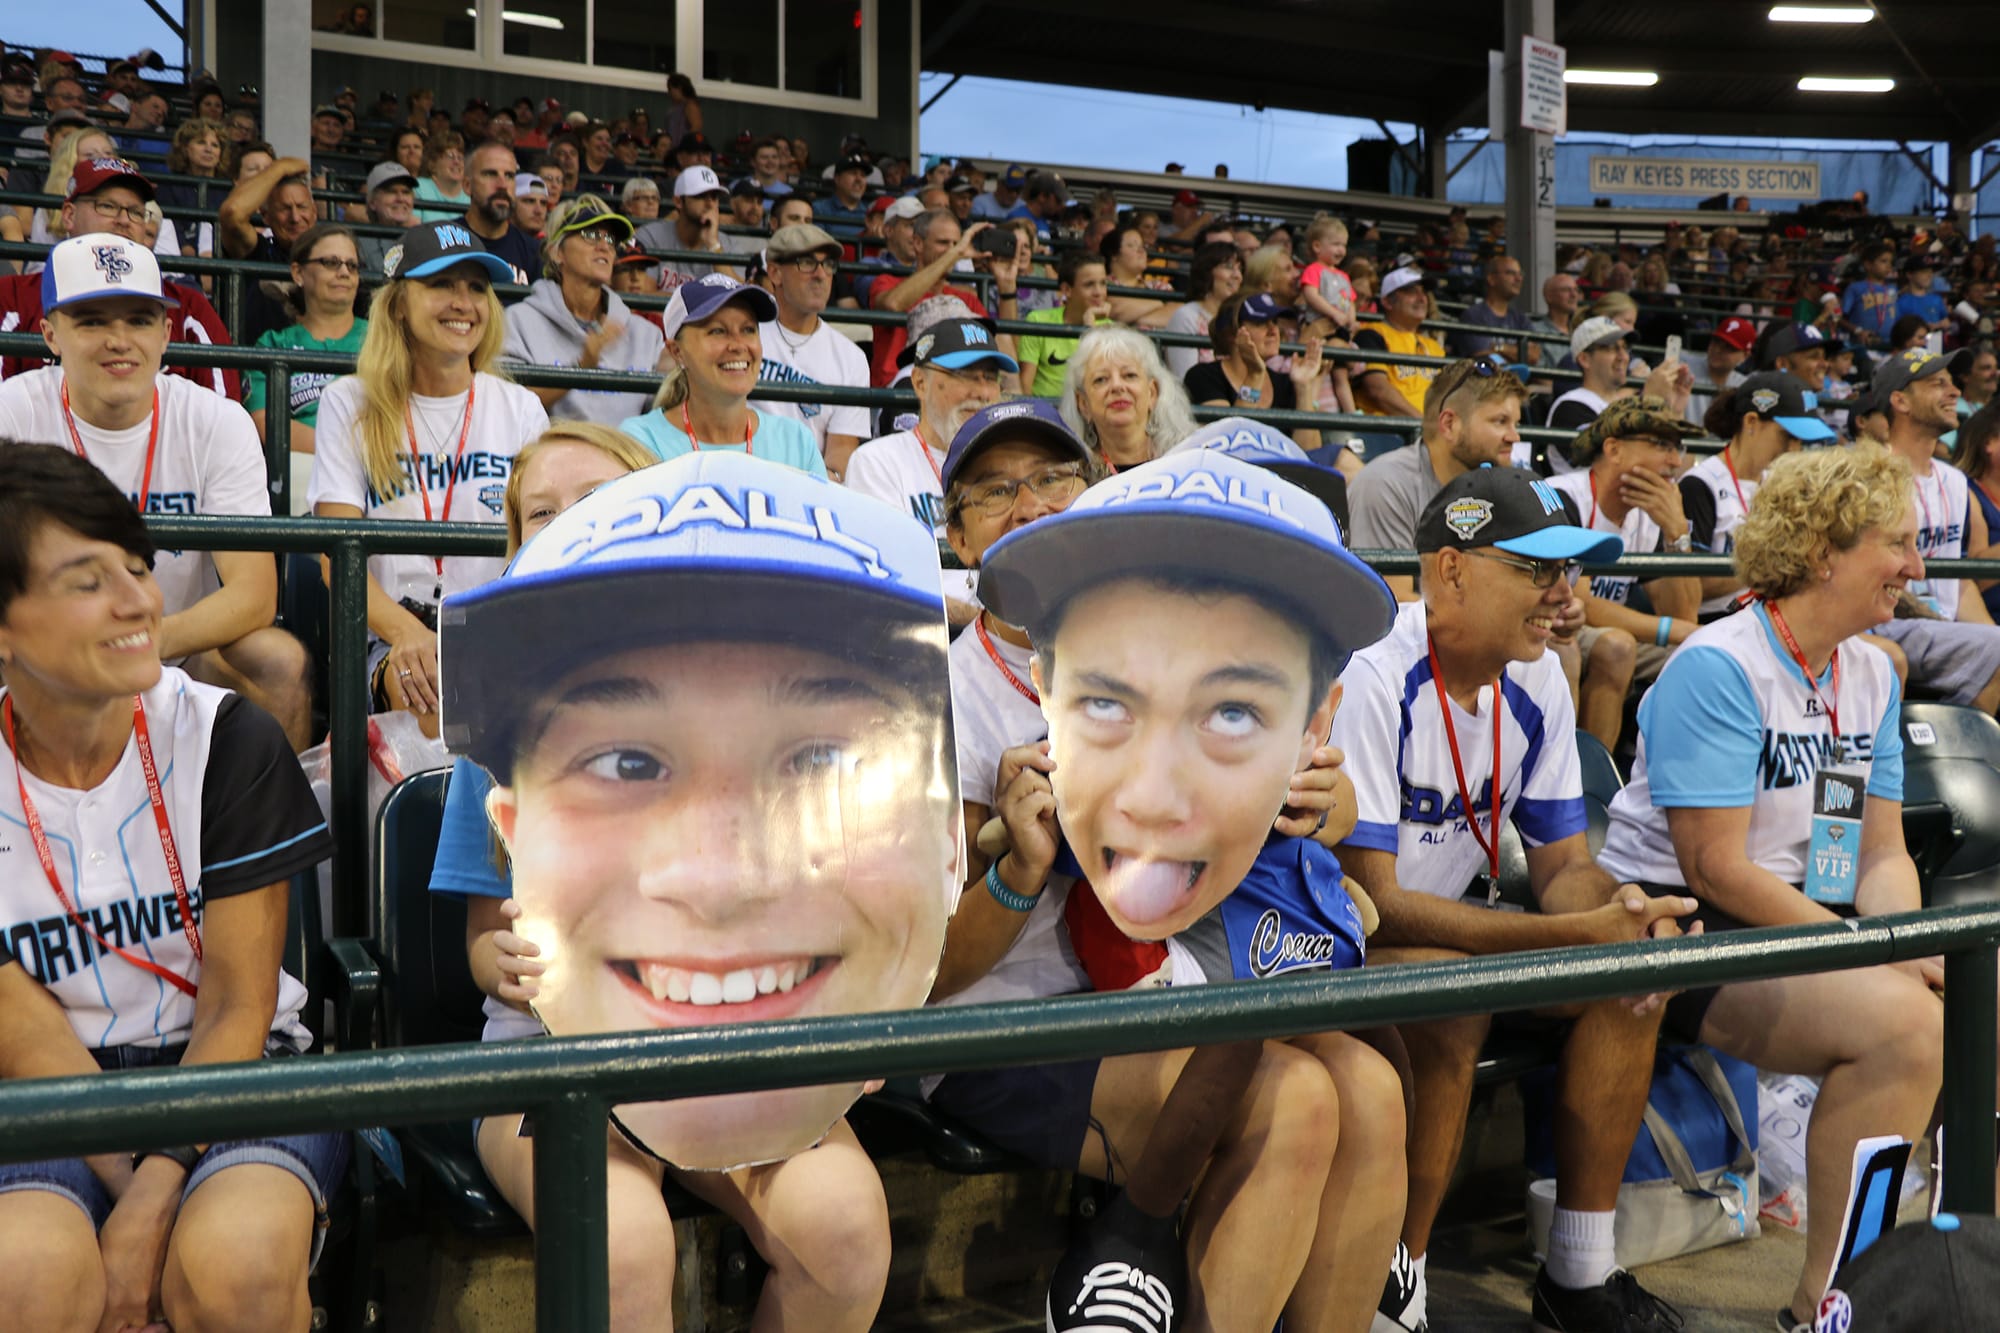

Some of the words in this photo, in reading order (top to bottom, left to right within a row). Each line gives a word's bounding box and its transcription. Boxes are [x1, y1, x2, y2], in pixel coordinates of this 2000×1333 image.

[1600, 164, 1628, 184] RAY
[1634, 166, 1684, 186] KEYES
[1690, 167, 1740, 188] PRESS
[1747, 168, 1812, 190] SECTION
[434, 224, 472, 250] NW
[960, 323, 989, 346] NW
[1824, 778, 1854, 812] NW
[1815, 857, 1851, 878] VIP
[1249, 908, 1334, 978] Coeur
